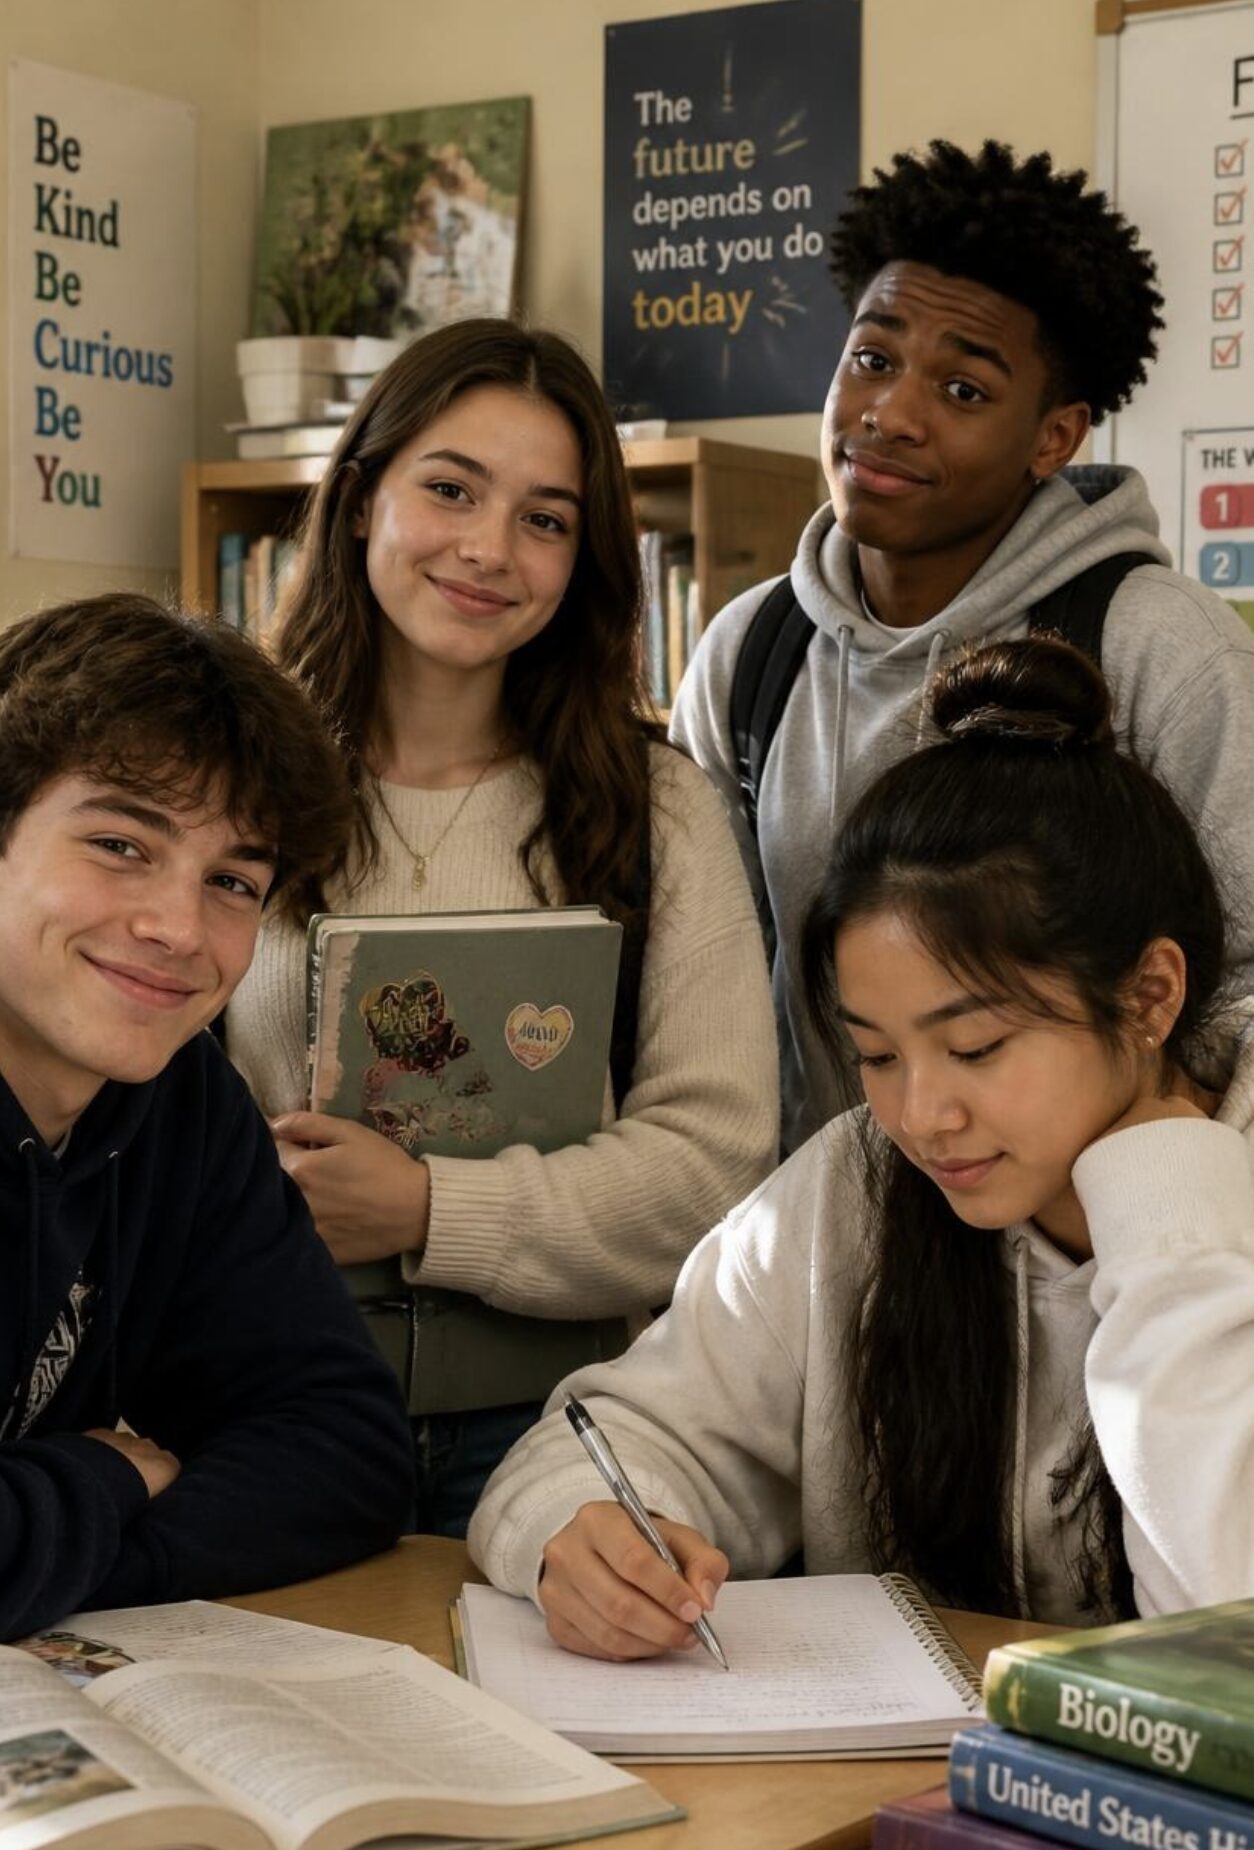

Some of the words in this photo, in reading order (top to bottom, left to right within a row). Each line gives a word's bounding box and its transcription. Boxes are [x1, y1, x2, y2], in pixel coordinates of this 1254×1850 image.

[634, 90, 692, 127] The
[34, 114, 81, 173] Be
[633, 137, 756, 179] future
[34, 182, 120, 249] Kind
[633, 182, 762, 231] depends
[772, 183, 812, 211] on
[633, 236, 707, 272] what
[716, 236, 773, 275] you
[783, 222, 824, 259] do
[34, 250, 82, 308] Be
[632, 281, 753, 335] today
[34, 317, 174, 389] Curious
[34, 385, 82, 442] Be
[34, 454, 101, 508] You
[1201, 448, 1236, 470] THE
[1215, 492, 1229, 522] 1
[1212, 551, 1230, 580] 2
[1057, 1682, 1200, 1773] Biology
[987, 1763, 1090, 1827] United
[1097, 1795, 1199, 1850] States
